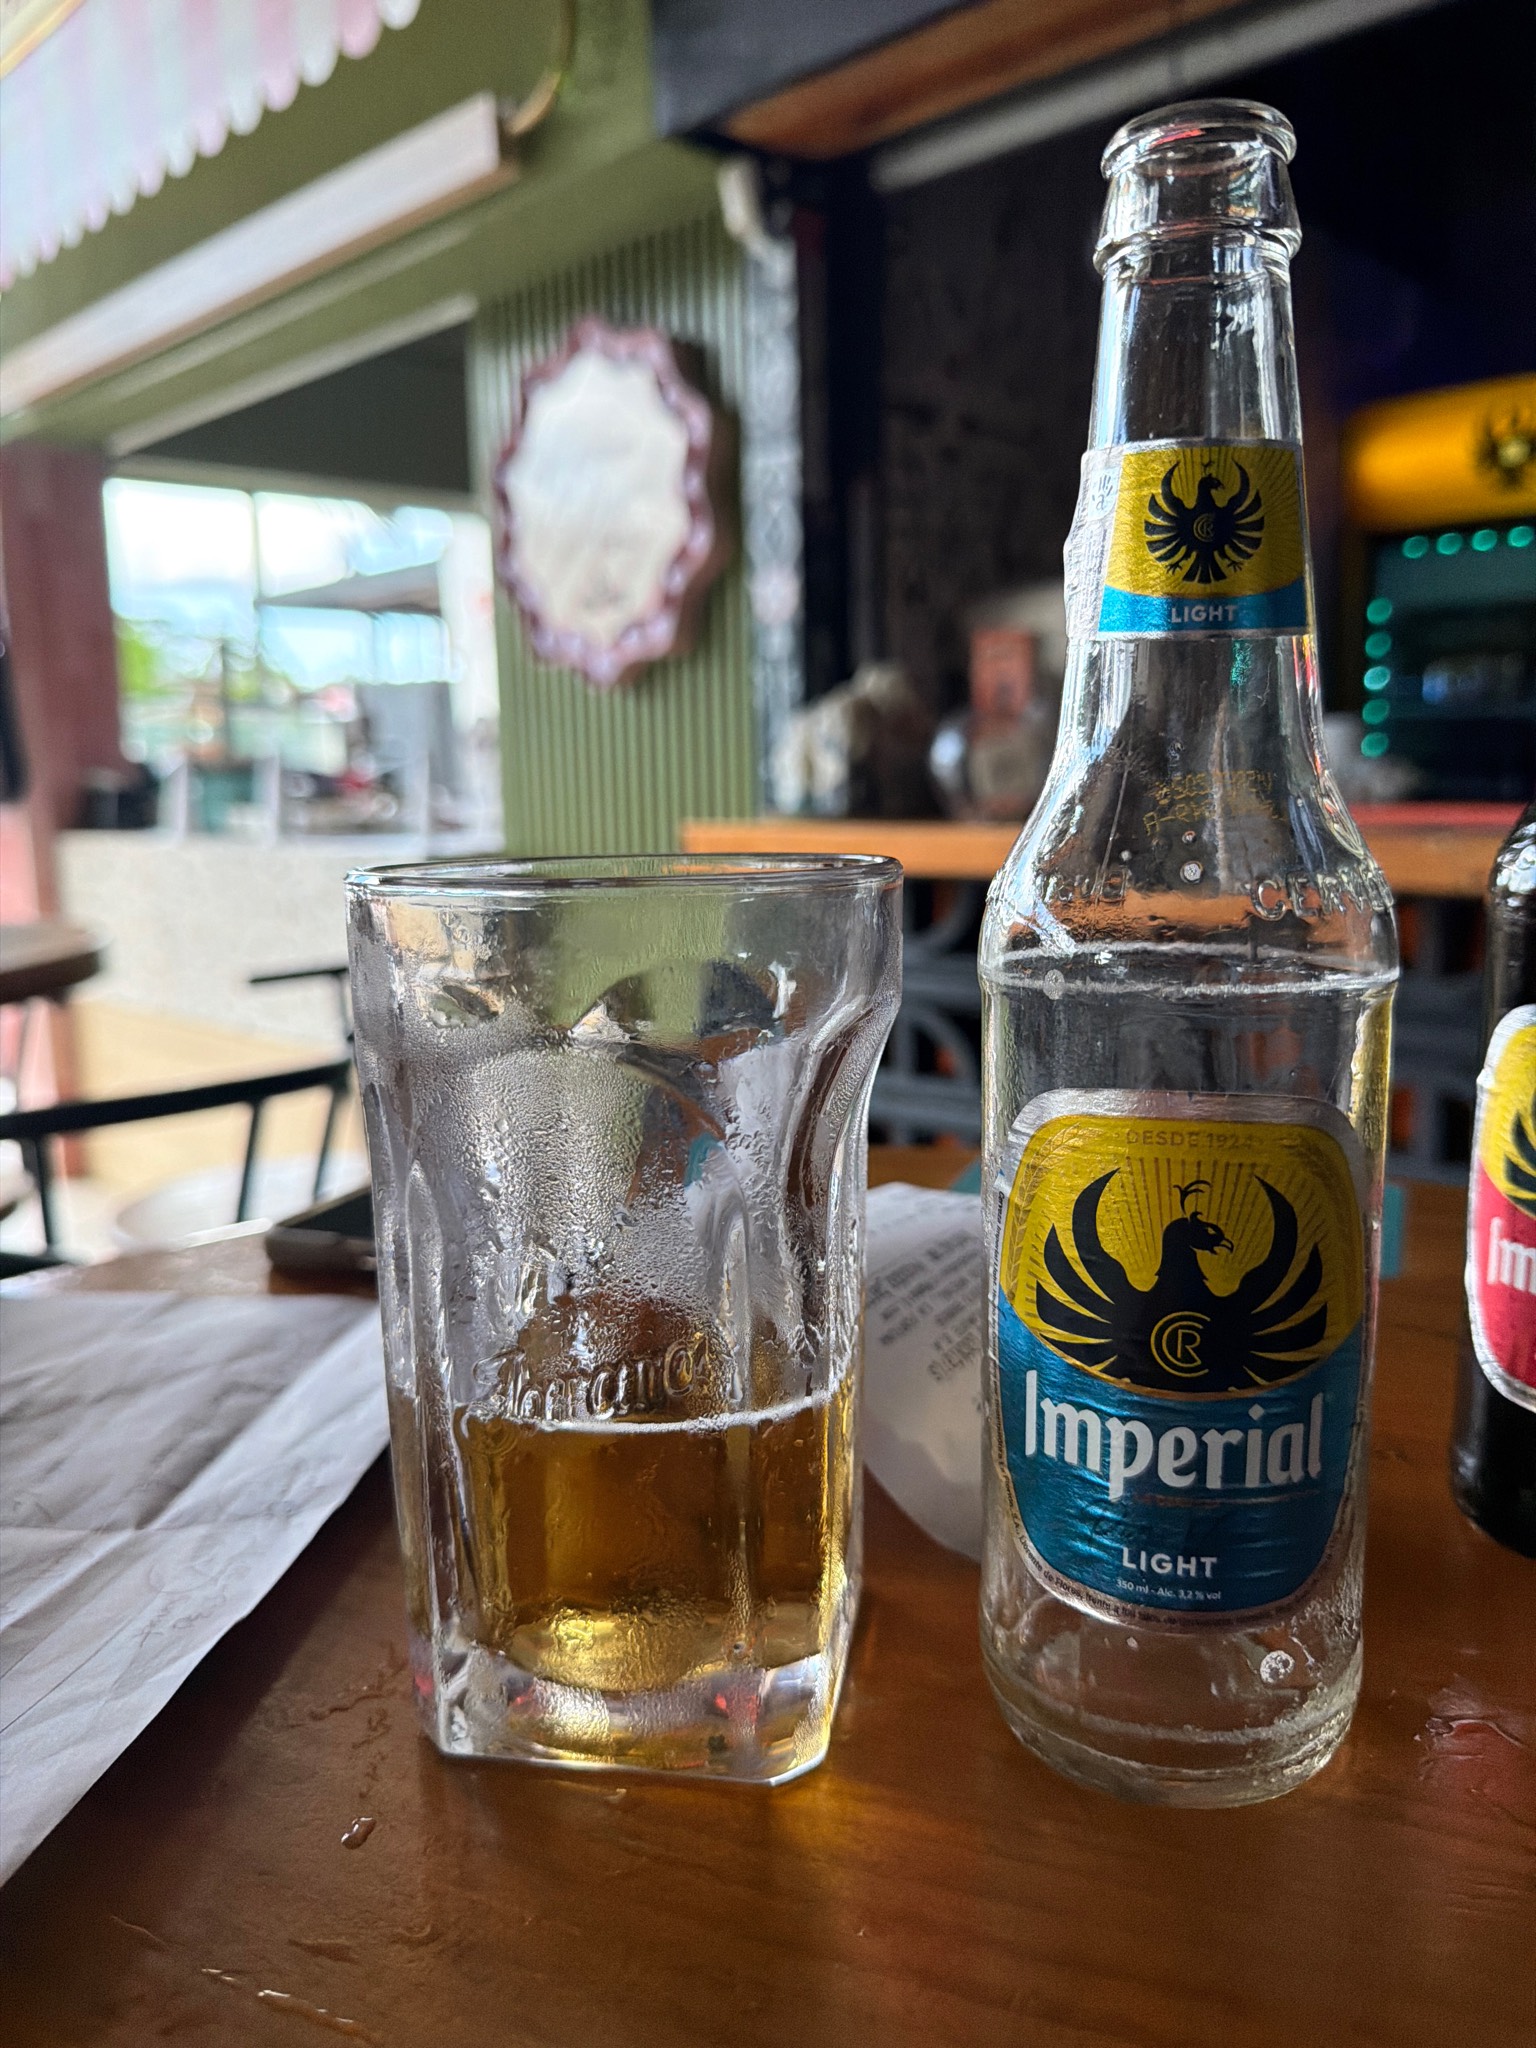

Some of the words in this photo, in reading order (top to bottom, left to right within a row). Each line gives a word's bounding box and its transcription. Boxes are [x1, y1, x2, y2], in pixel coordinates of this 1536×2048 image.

[1171, 605, 1239, 624] LIGHT
[1126, 1130, 1201, 1148] DESDE
[1206, 1133, 1255, 1150] 1924
[1025, 1370, 1324, 1500] Imperial
[1122, 1547, 1218, 1578] LIGHT
[1116, 1579, 1134, 1590] 350
[1157, 1587, 1176, 1597] Alc.
[1206, 1591, 1222, 1601] vol
